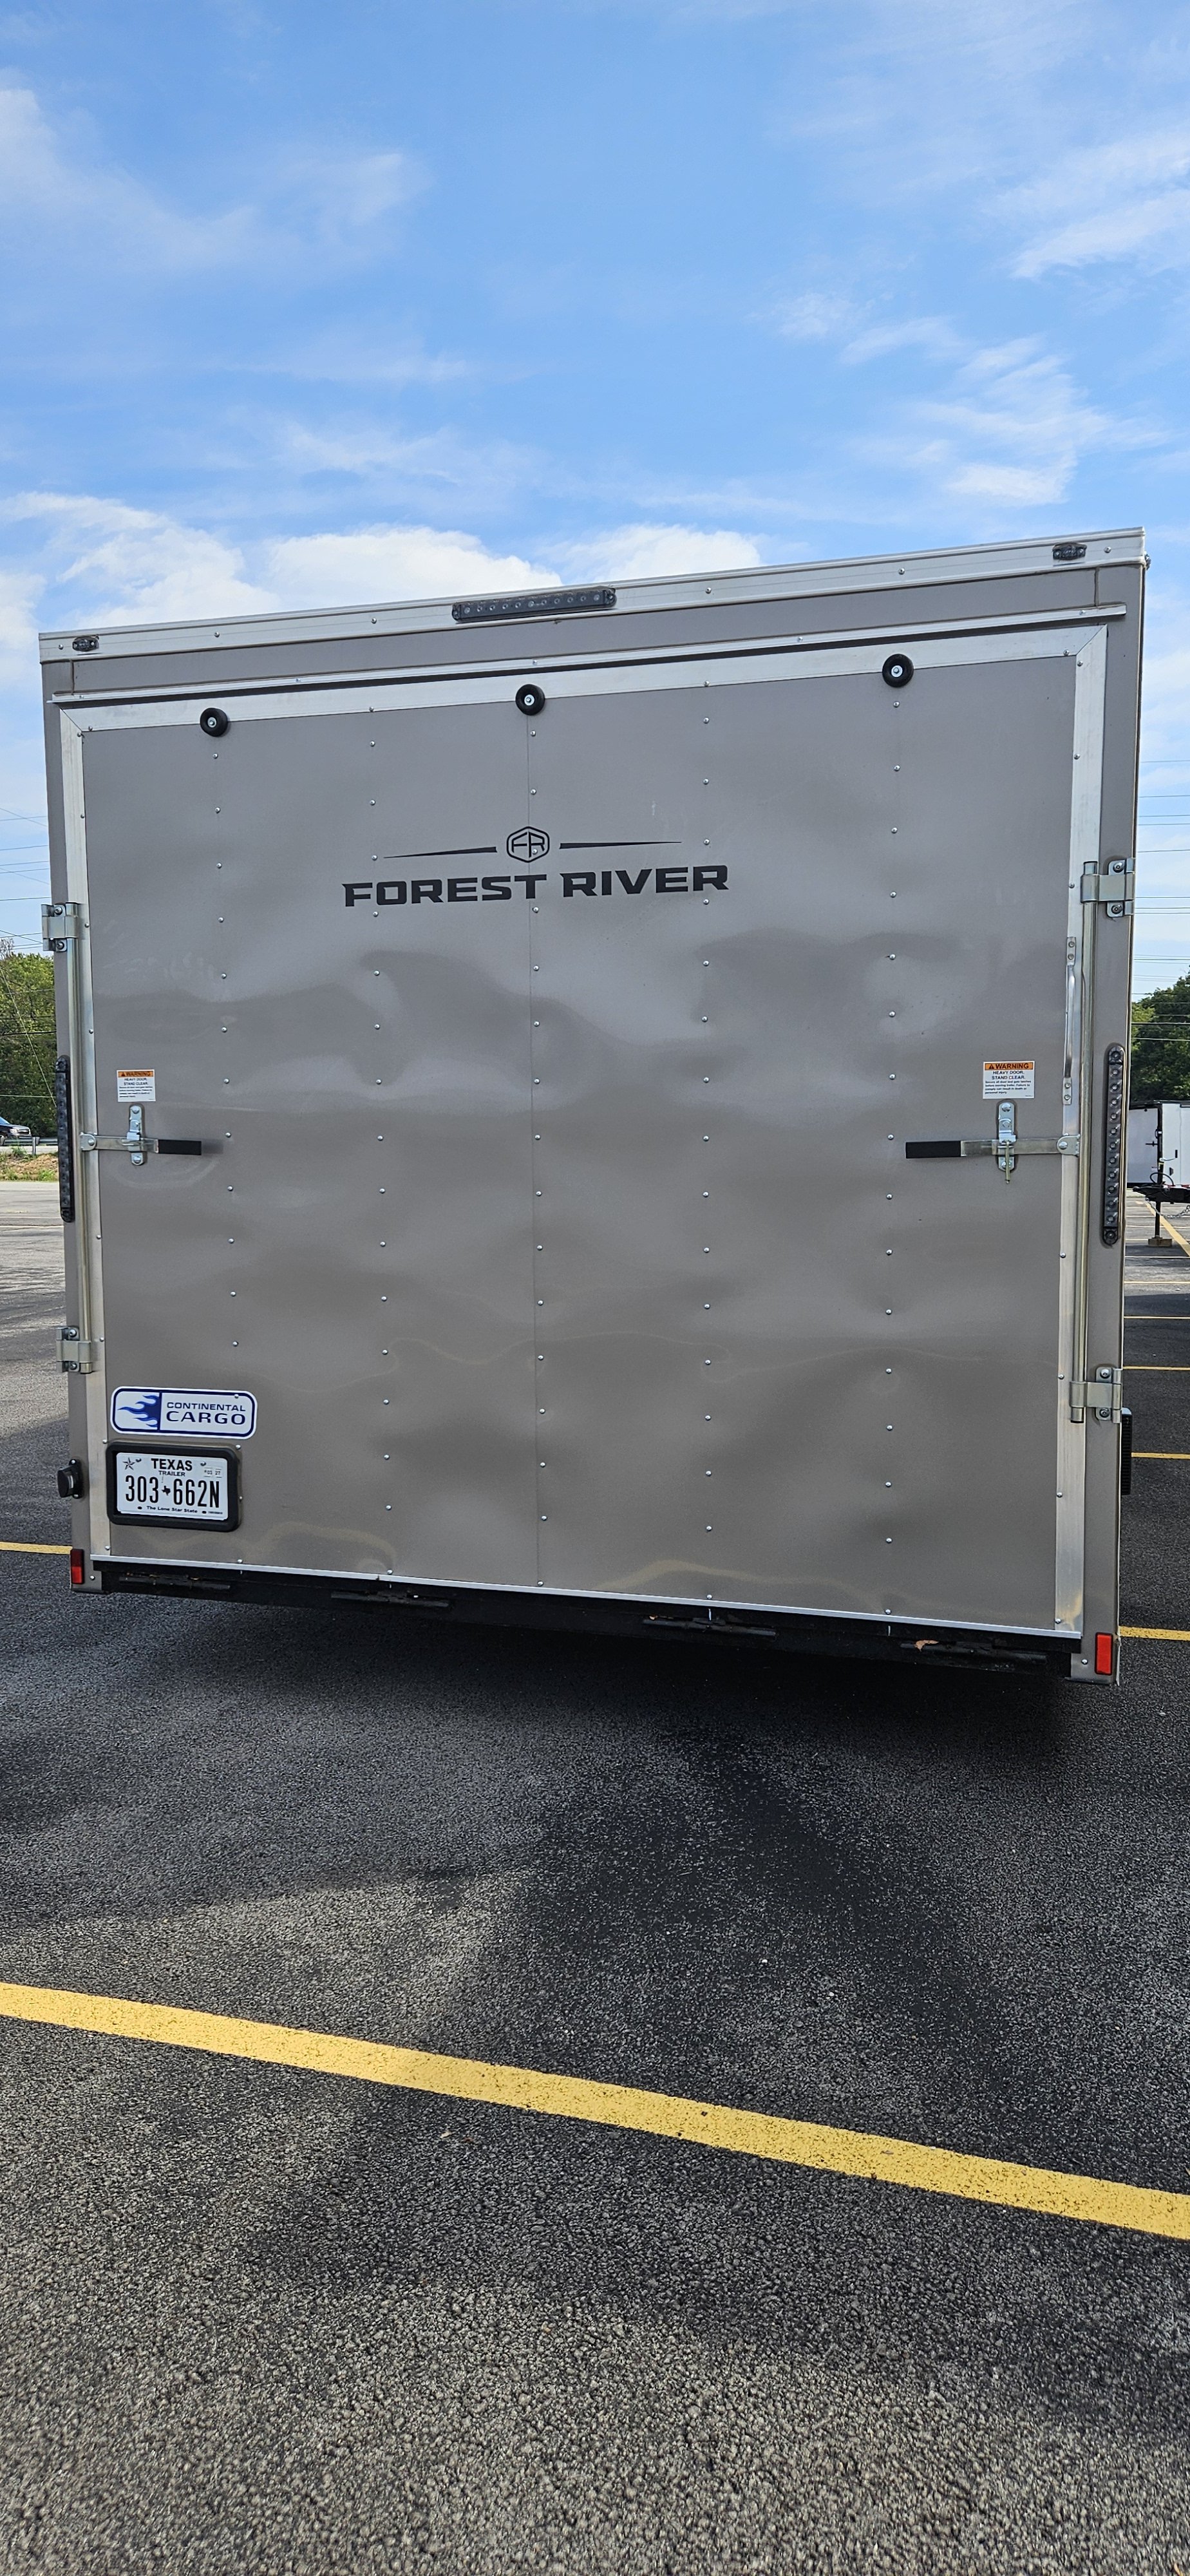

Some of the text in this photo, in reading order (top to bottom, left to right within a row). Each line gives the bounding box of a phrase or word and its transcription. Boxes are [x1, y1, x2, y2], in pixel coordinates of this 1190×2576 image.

[341, 865, 729, 907] FOREST RIVER
[167, 1402, 246, 1412] CONTINENTAL
[166, 1411, 246, 1425] CARGO
[151, 1458, 193, 1471] TEXAS
[126, 1475, 220, 1508] 303 662N
